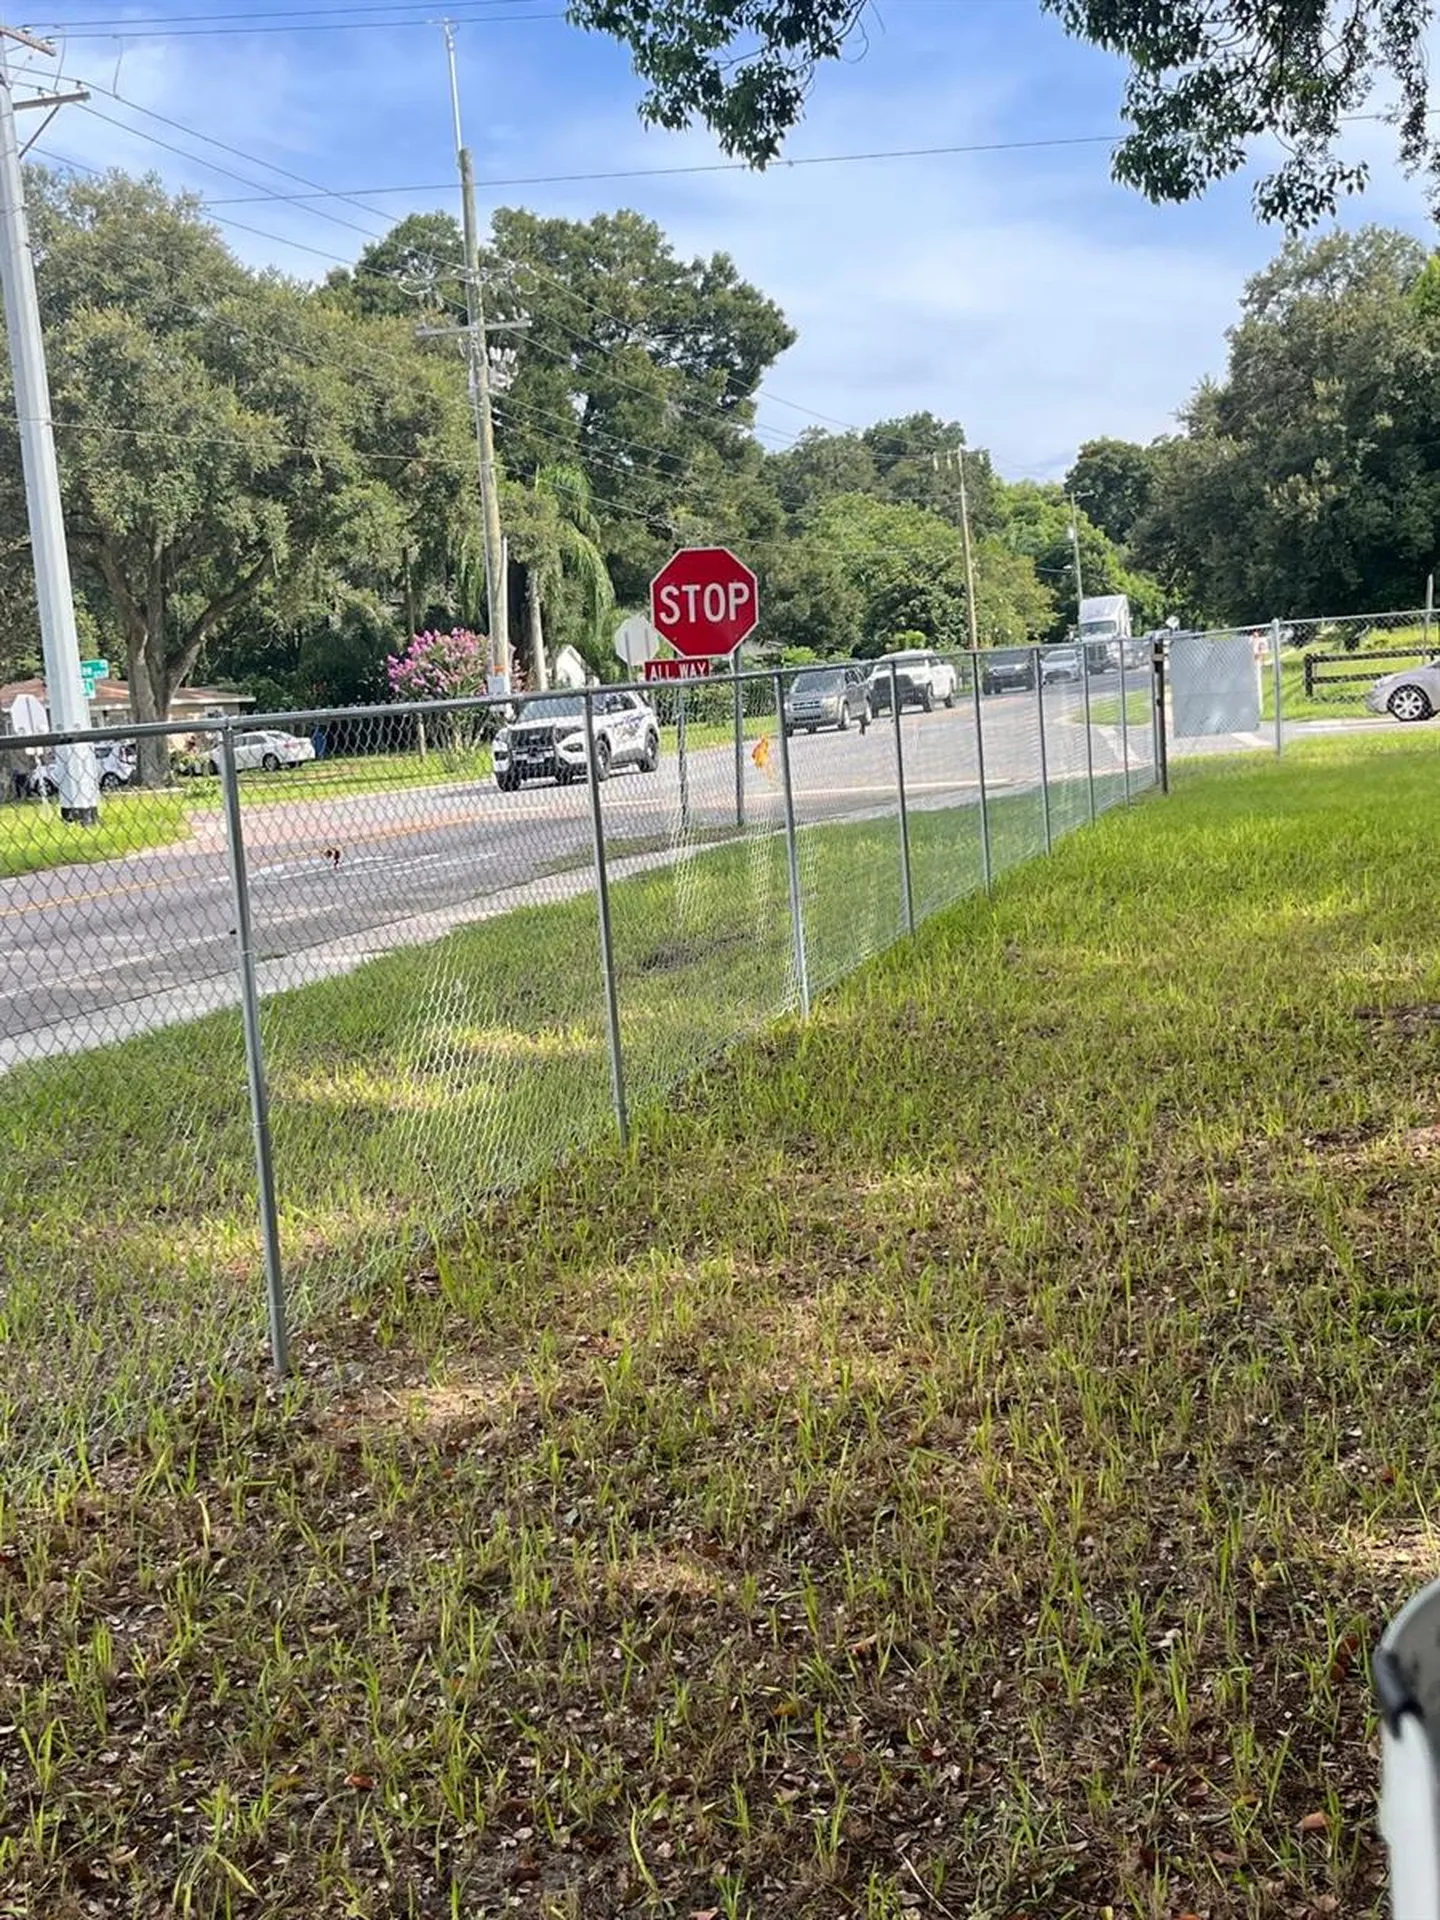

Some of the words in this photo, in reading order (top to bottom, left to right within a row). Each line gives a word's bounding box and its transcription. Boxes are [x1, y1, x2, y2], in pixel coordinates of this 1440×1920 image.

[659, 582, 750, 625] STOP
[650, 664, 675, 681] ALL
[678, 661, 706, 679] WAY
